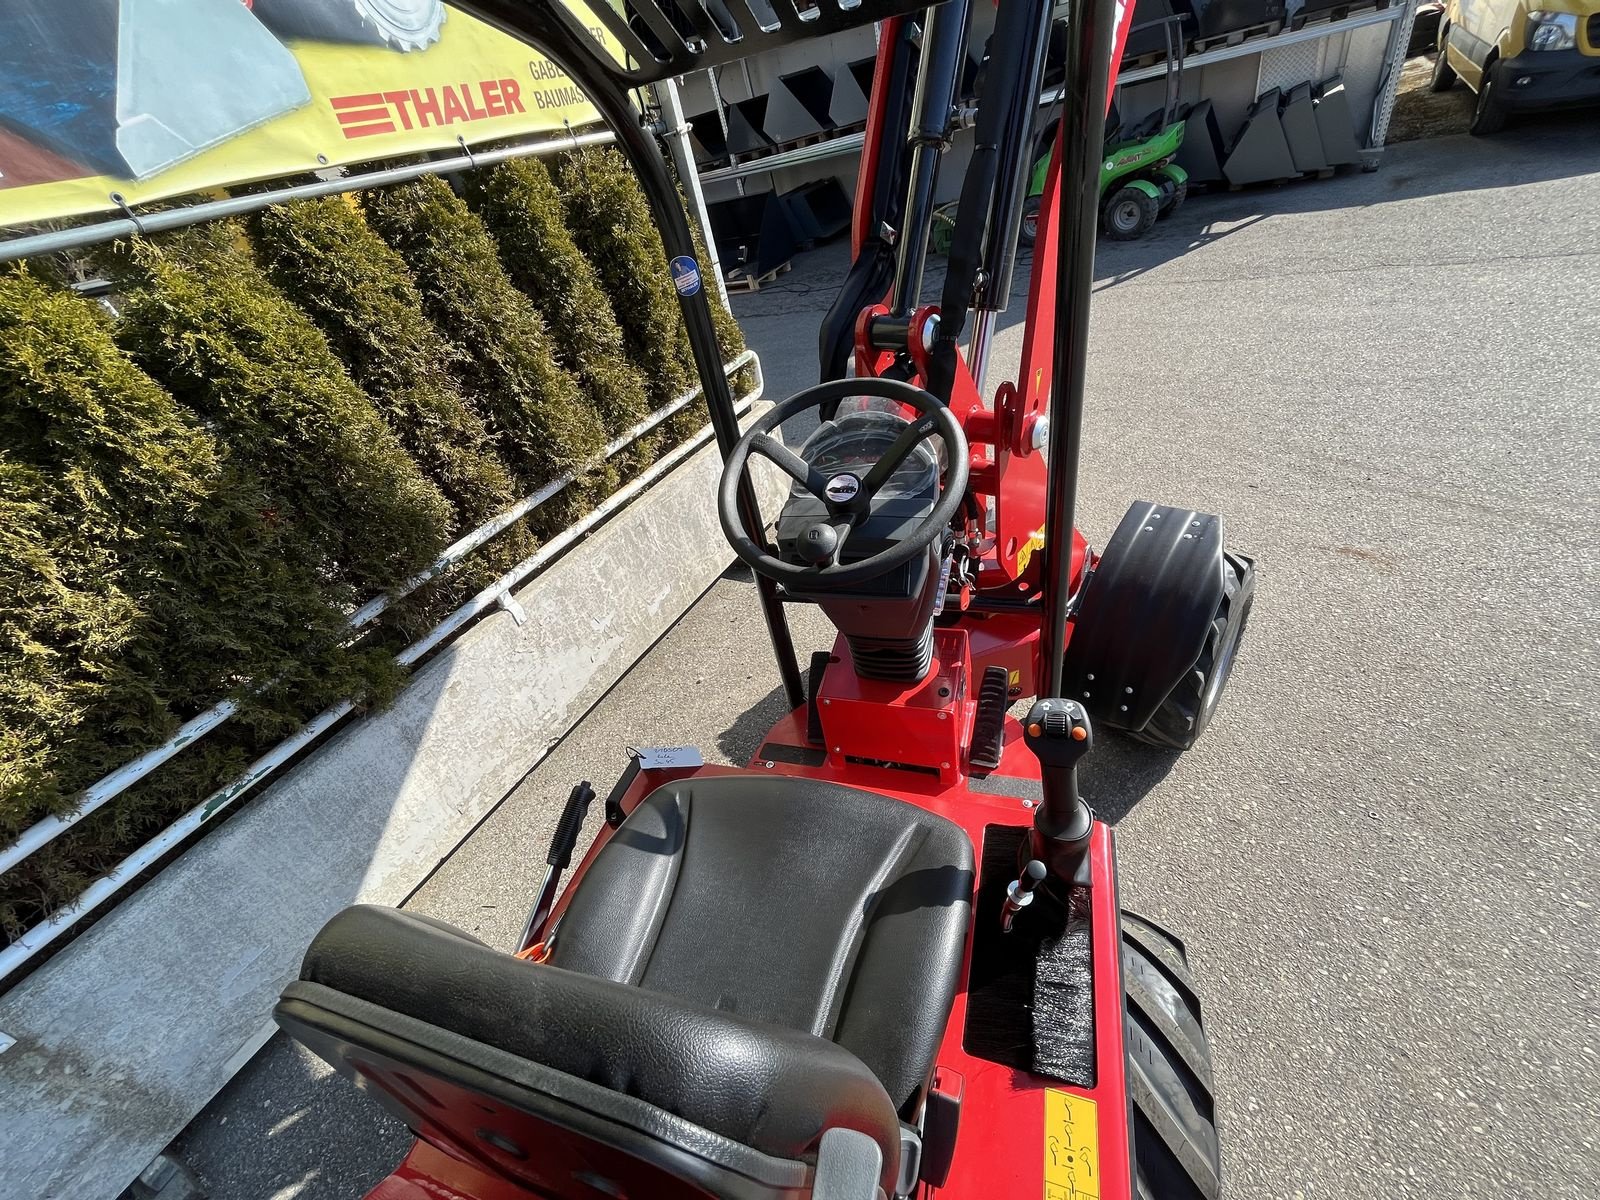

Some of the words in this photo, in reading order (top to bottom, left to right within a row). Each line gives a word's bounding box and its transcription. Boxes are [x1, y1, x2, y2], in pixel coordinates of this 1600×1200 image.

[589, 26, 607, 45] ER
[528, 60, 566, 81] GABE
[382, 78, 527, 131] THALER
[533, 86, 587, 110] BAUMAS
